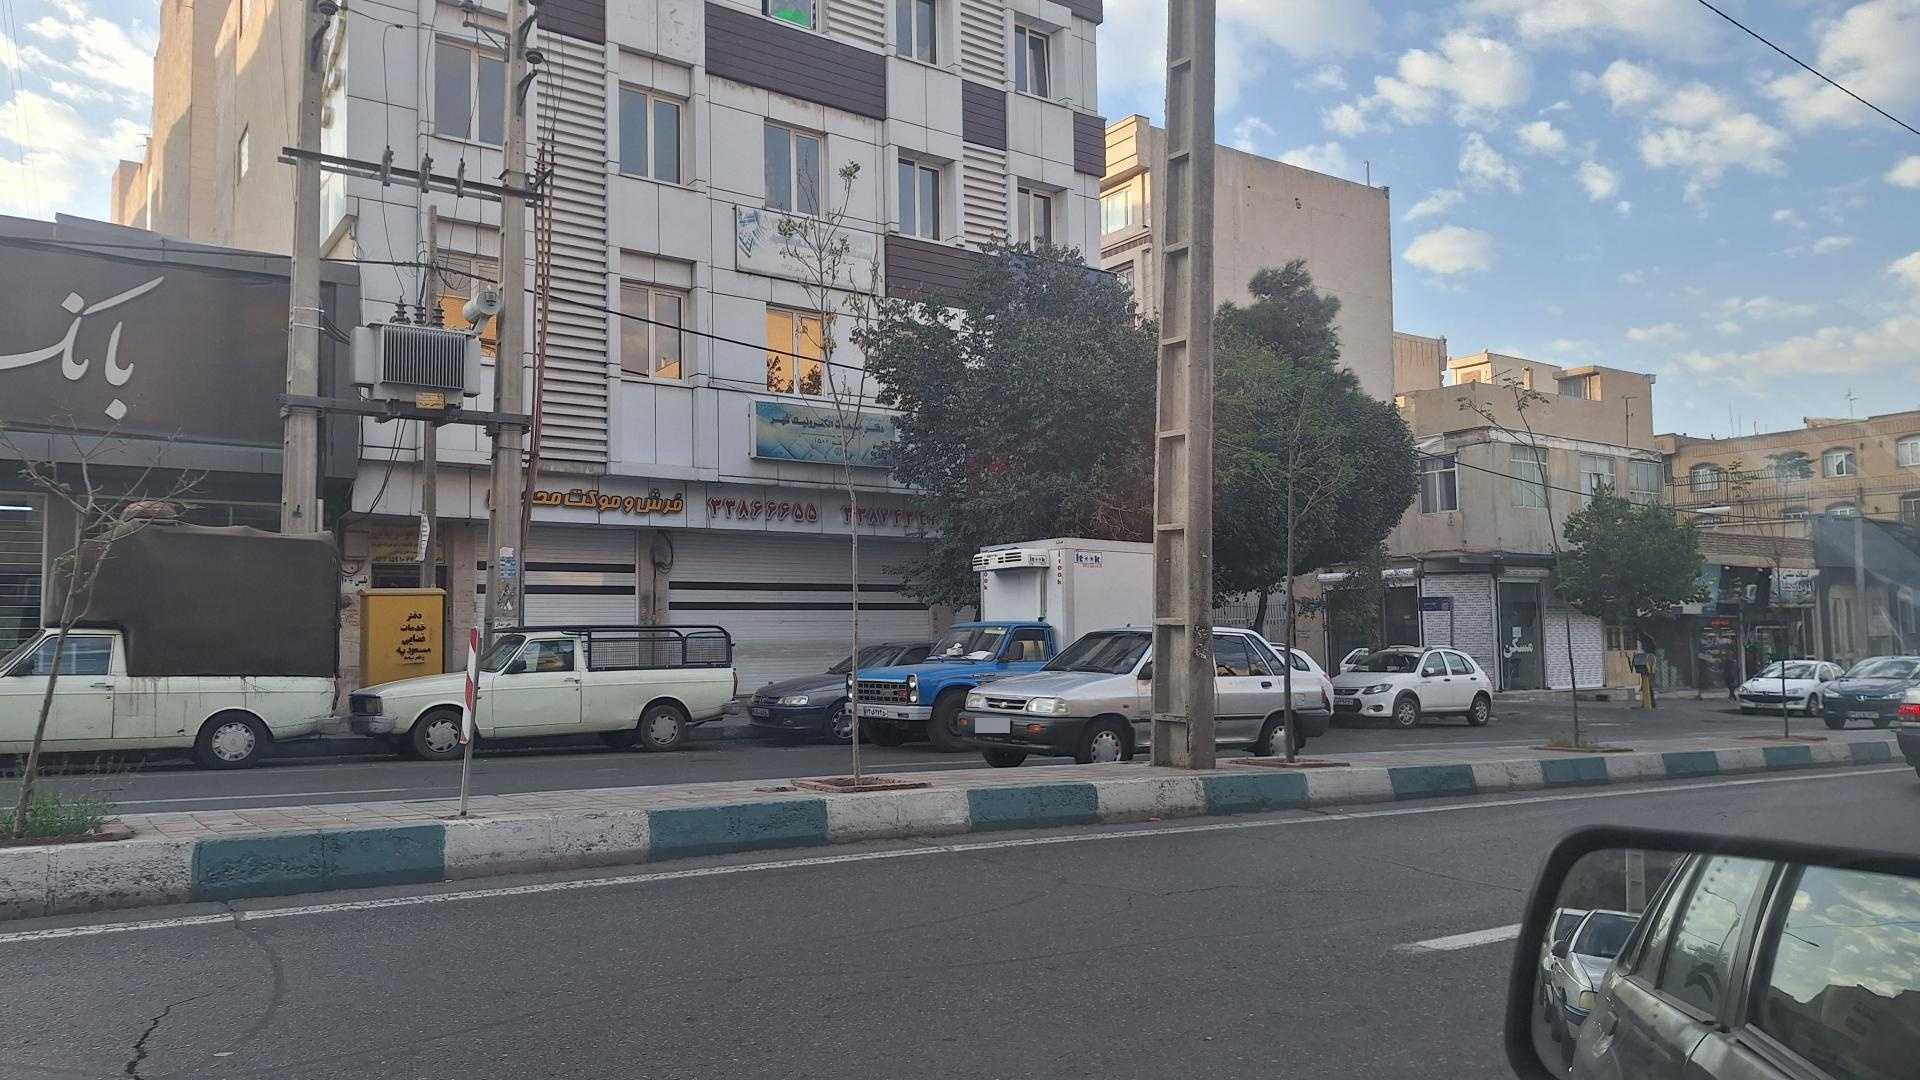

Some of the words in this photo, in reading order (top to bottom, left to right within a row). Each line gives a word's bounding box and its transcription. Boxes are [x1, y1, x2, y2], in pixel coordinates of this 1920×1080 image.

[0, 275, 165, 421] بانک
[563, 488, 622, 513] موکت
[620, 496, 634, 514] و
[635, 487, 685, 514] فرش
[709, 496, 819, 523] ۳۳۸۶۶۶۵۵
[400, 623, 426, 631] خدمات
[406, 610, 423, 622] دفتر
[1503, 637, 1534, 659] مسکن
